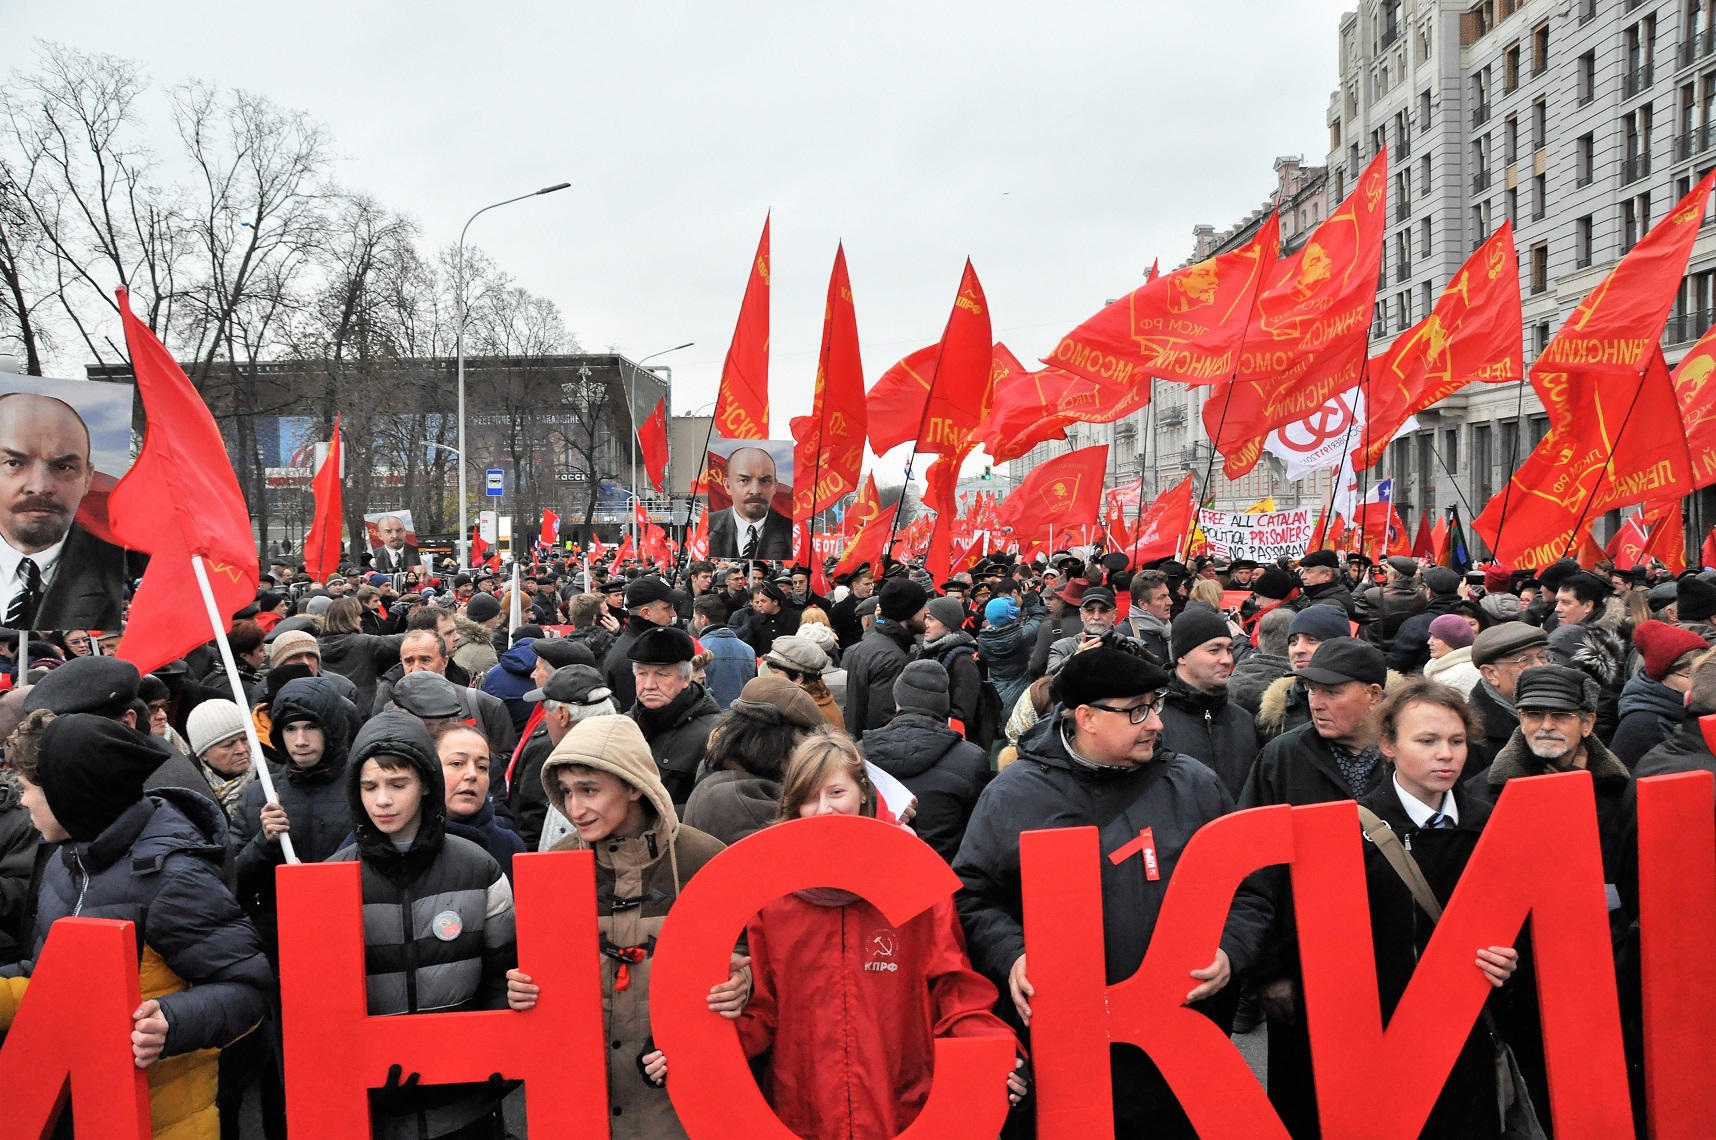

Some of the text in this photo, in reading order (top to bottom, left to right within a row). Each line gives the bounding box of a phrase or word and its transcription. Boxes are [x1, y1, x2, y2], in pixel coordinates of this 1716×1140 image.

[955, 296, 982, 315] КПРФ
[1201, 509, 1308, 528] FREE ALL CATALAN
[1228, 542, 1307, 561] NO PASSARAN
[864, 961, 898, 972] КПРФ
